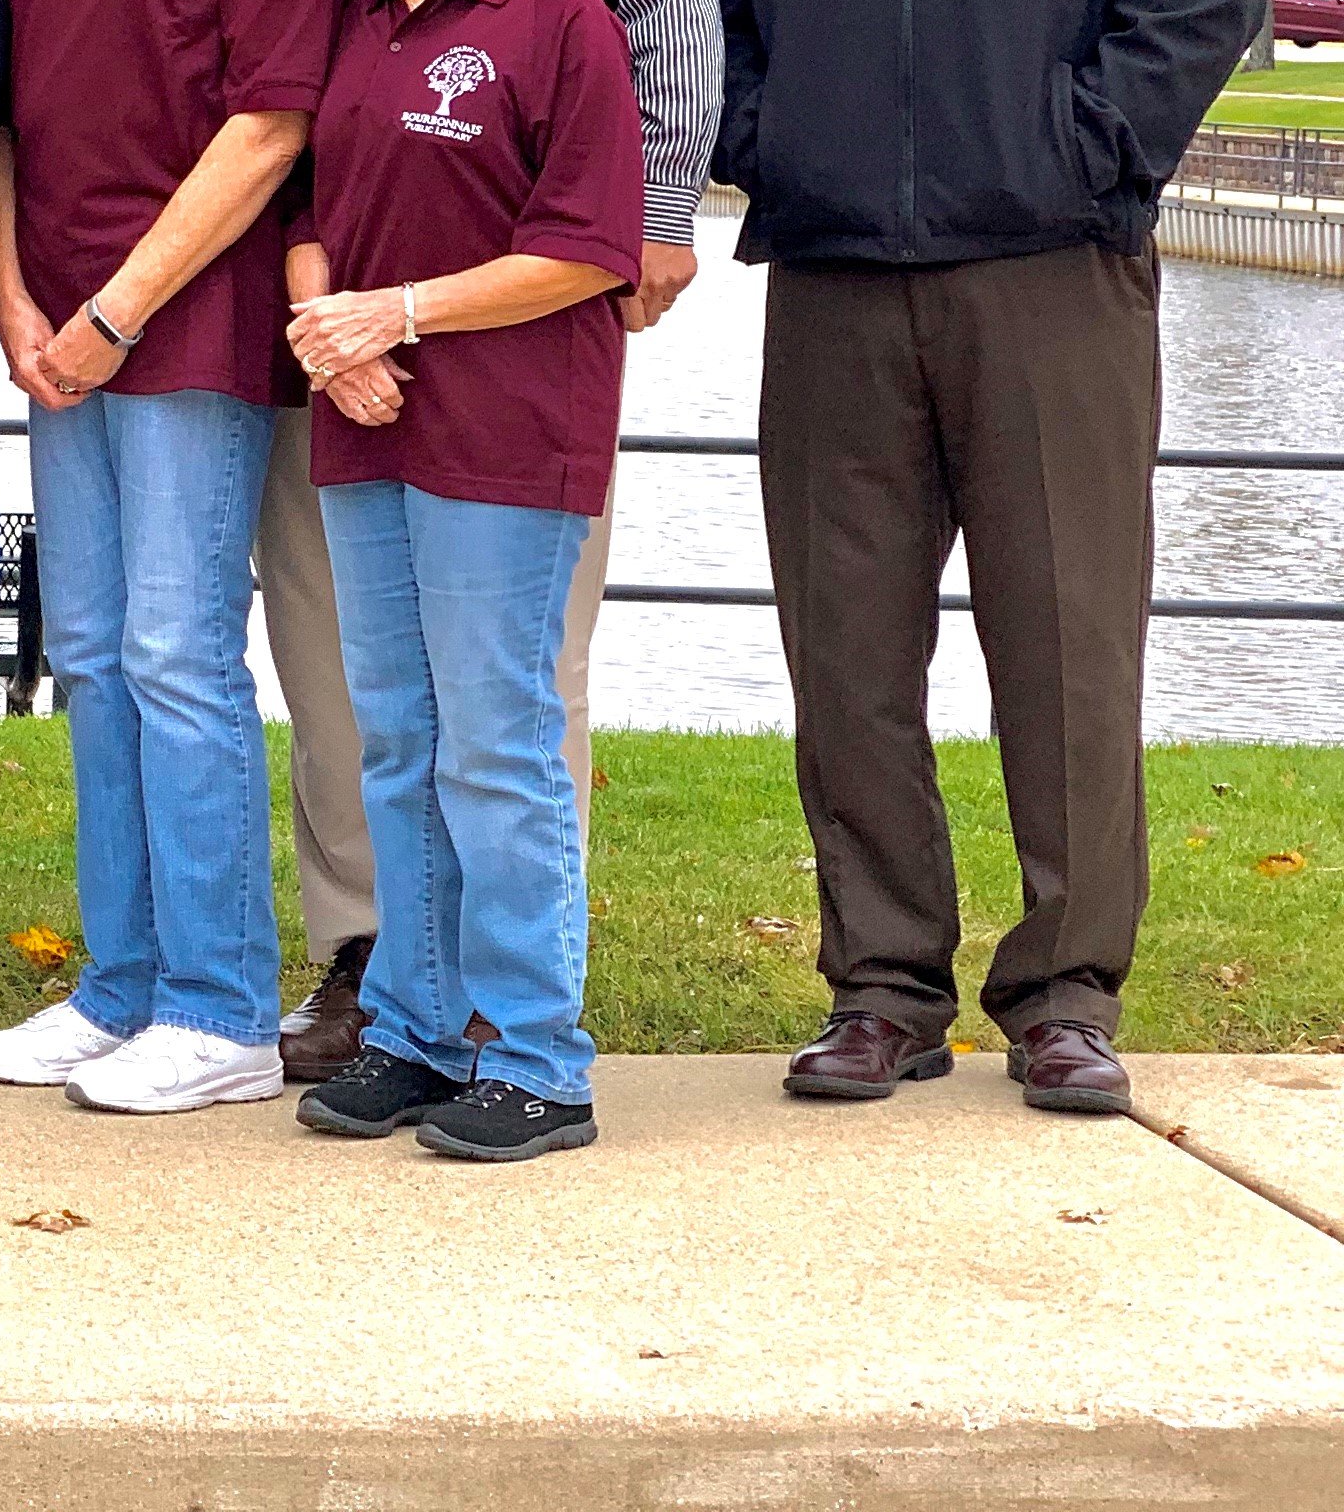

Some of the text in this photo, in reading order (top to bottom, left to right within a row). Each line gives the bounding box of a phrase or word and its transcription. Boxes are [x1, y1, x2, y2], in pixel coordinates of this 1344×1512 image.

[401, 111, 483, 136] BOURBONNAIS
[404, 121, 473, 142] PUBLIC LIBRARY
